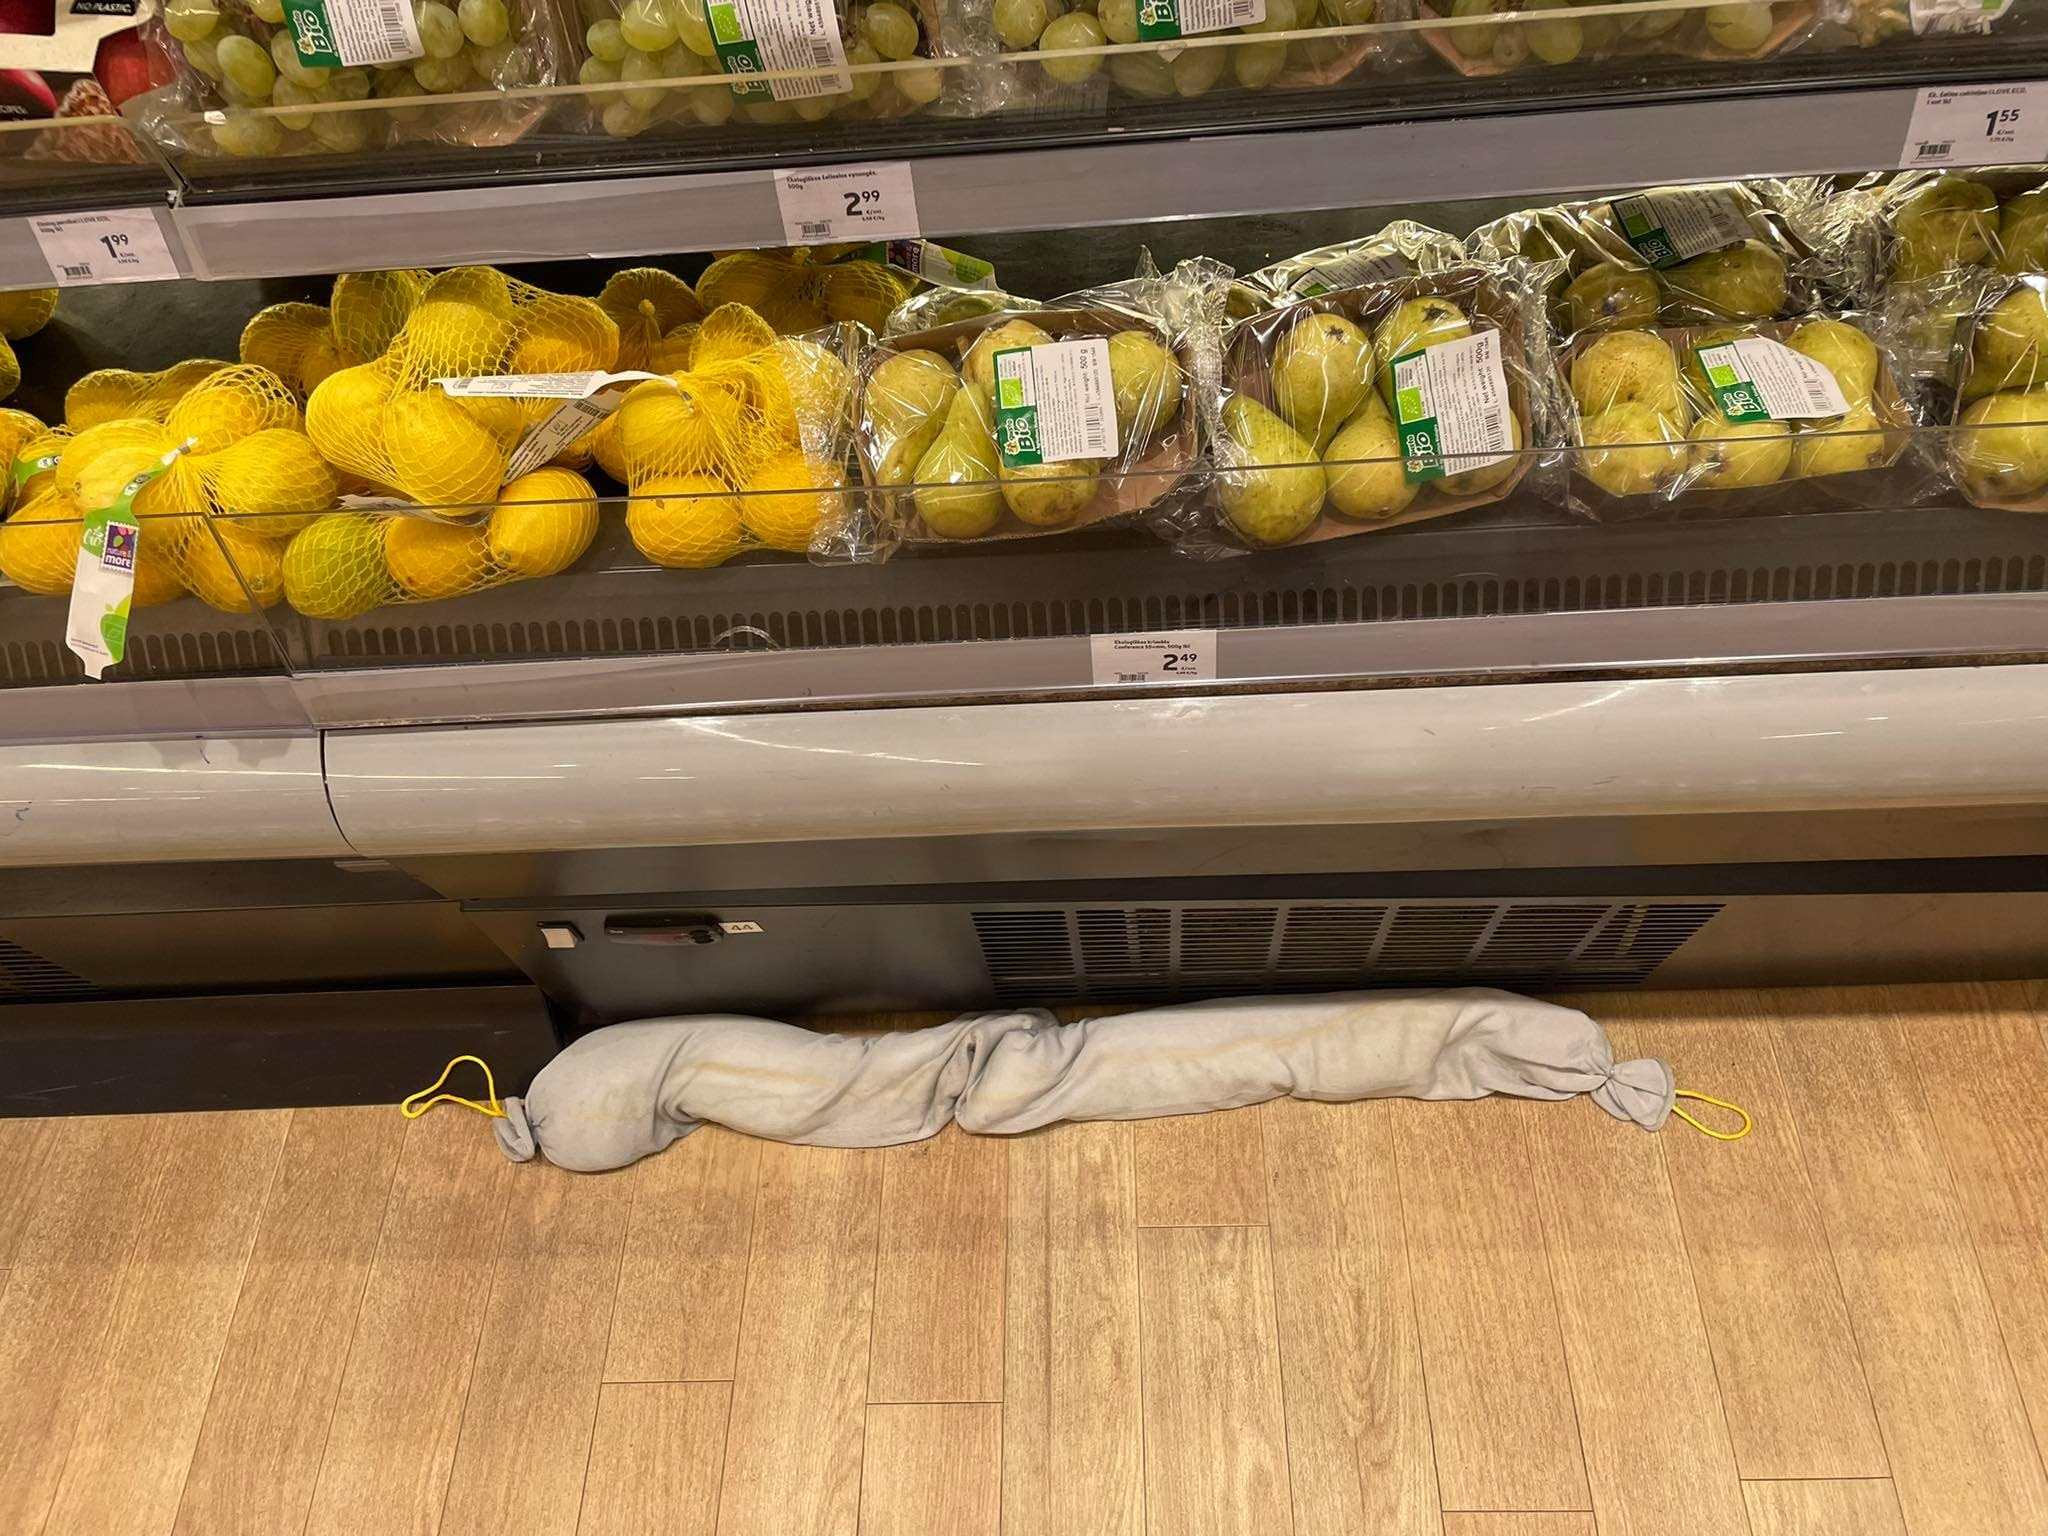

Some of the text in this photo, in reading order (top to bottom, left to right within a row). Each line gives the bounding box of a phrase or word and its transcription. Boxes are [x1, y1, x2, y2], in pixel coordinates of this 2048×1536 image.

[76, 3, 92, 11] NO
[912, 247, 920, 273] more
[105, 554, 131, 567] more
